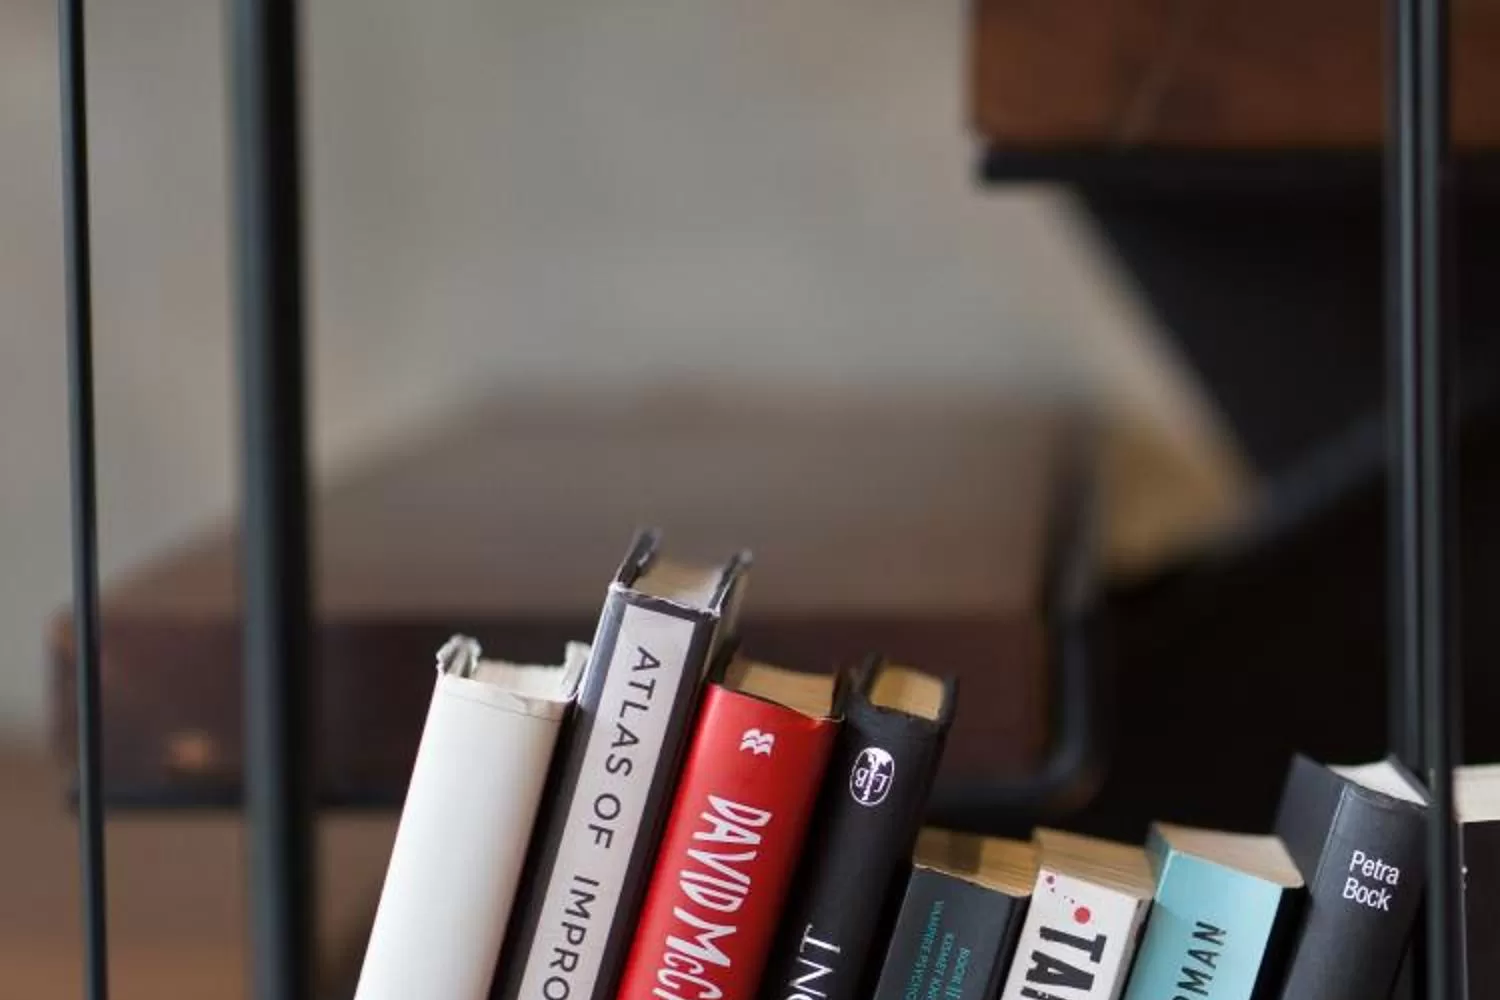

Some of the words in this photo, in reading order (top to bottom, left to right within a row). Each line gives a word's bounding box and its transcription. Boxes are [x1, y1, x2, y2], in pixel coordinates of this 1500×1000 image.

[605, 645, 661, 777] ATLAS
[586, 791, 621, 850] OF
[679, 794, 773, 914] DAVID
[1348, 849, 1402, 886] Petra
[1341, 877, 1394, 912] Bock
